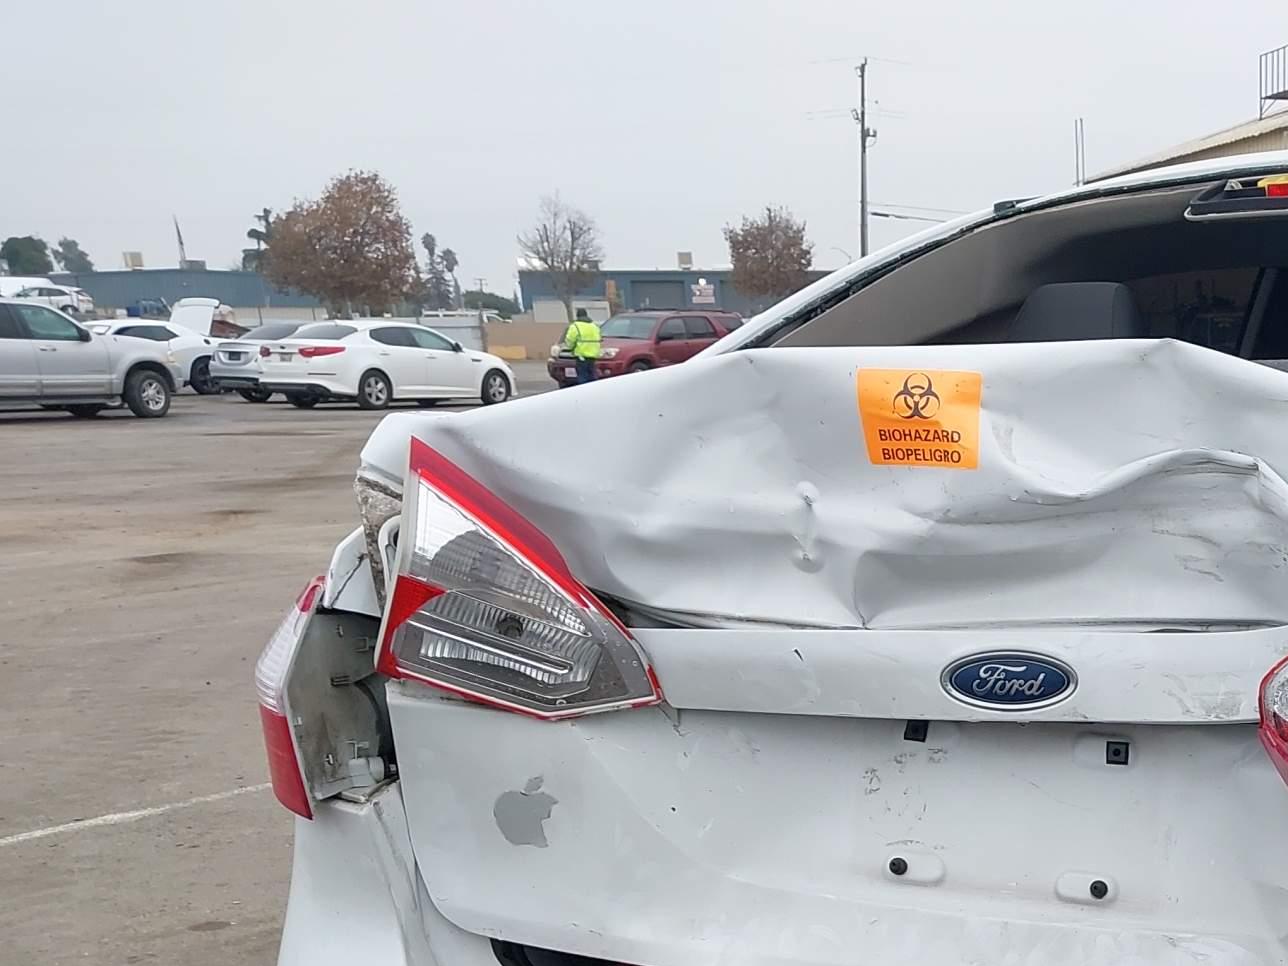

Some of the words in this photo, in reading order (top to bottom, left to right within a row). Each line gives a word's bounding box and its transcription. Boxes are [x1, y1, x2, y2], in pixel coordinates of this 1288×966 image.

[878, 428, 962, 444] BIOHAZARD
[881, 447, 962, 464] BIOPELIGRO
[972, 663, 1046, 697] Ford
